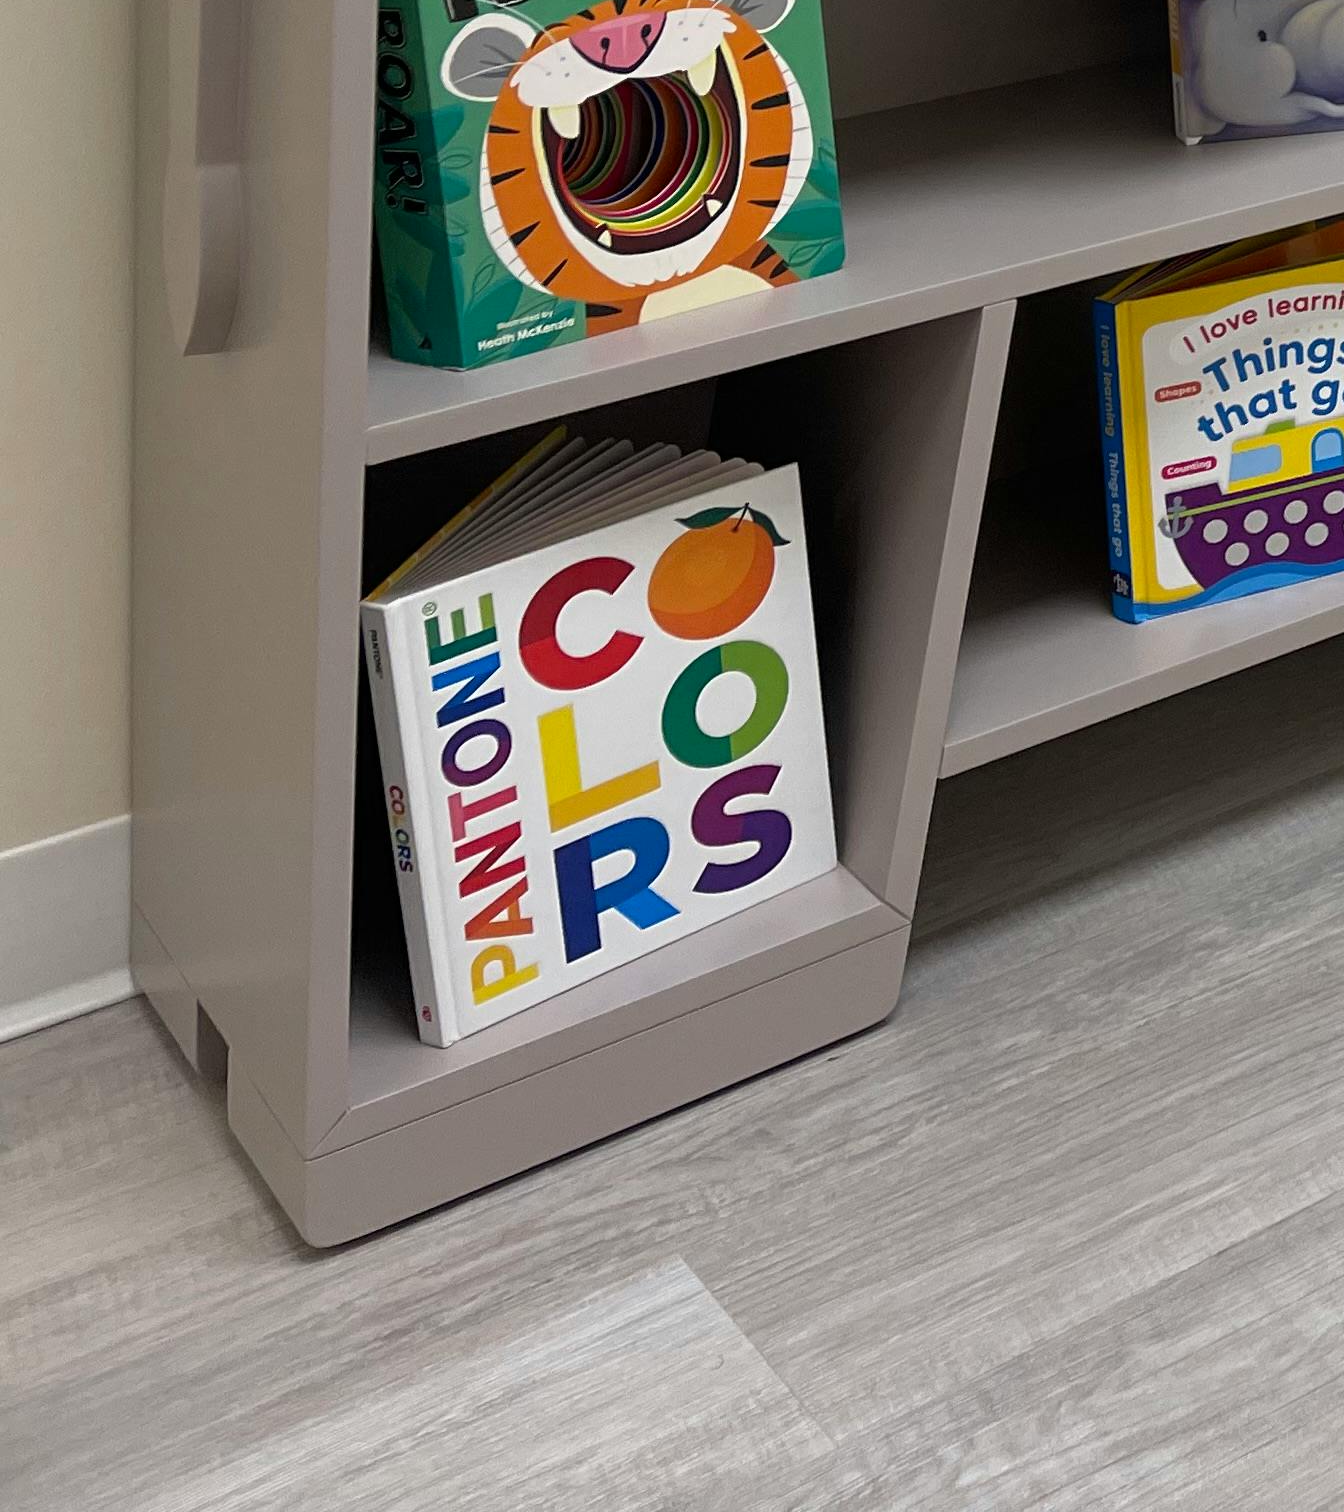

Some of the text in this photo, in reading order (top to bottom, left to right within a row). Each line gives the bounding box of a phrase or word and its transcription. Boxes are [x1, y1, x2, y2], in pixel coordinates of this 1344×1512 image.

[477, 317, 576, 351] Heath McKenzie
[1183, 336, 1196, 353] I
[1200, 310, 1258, 343] love
[1101, 334, 1110, 368] love
[1103, 372, 1116, 437] learning
[1160, 386, 1198, 399] Shapes
[1197, 379, 1298, 442] that
[1108, 452, 1119, 498] Things
[1167, 460, 1213, 476] Counting
[1112, 502, 1122, 534] that
[1111, 536, 1123, 558] go
